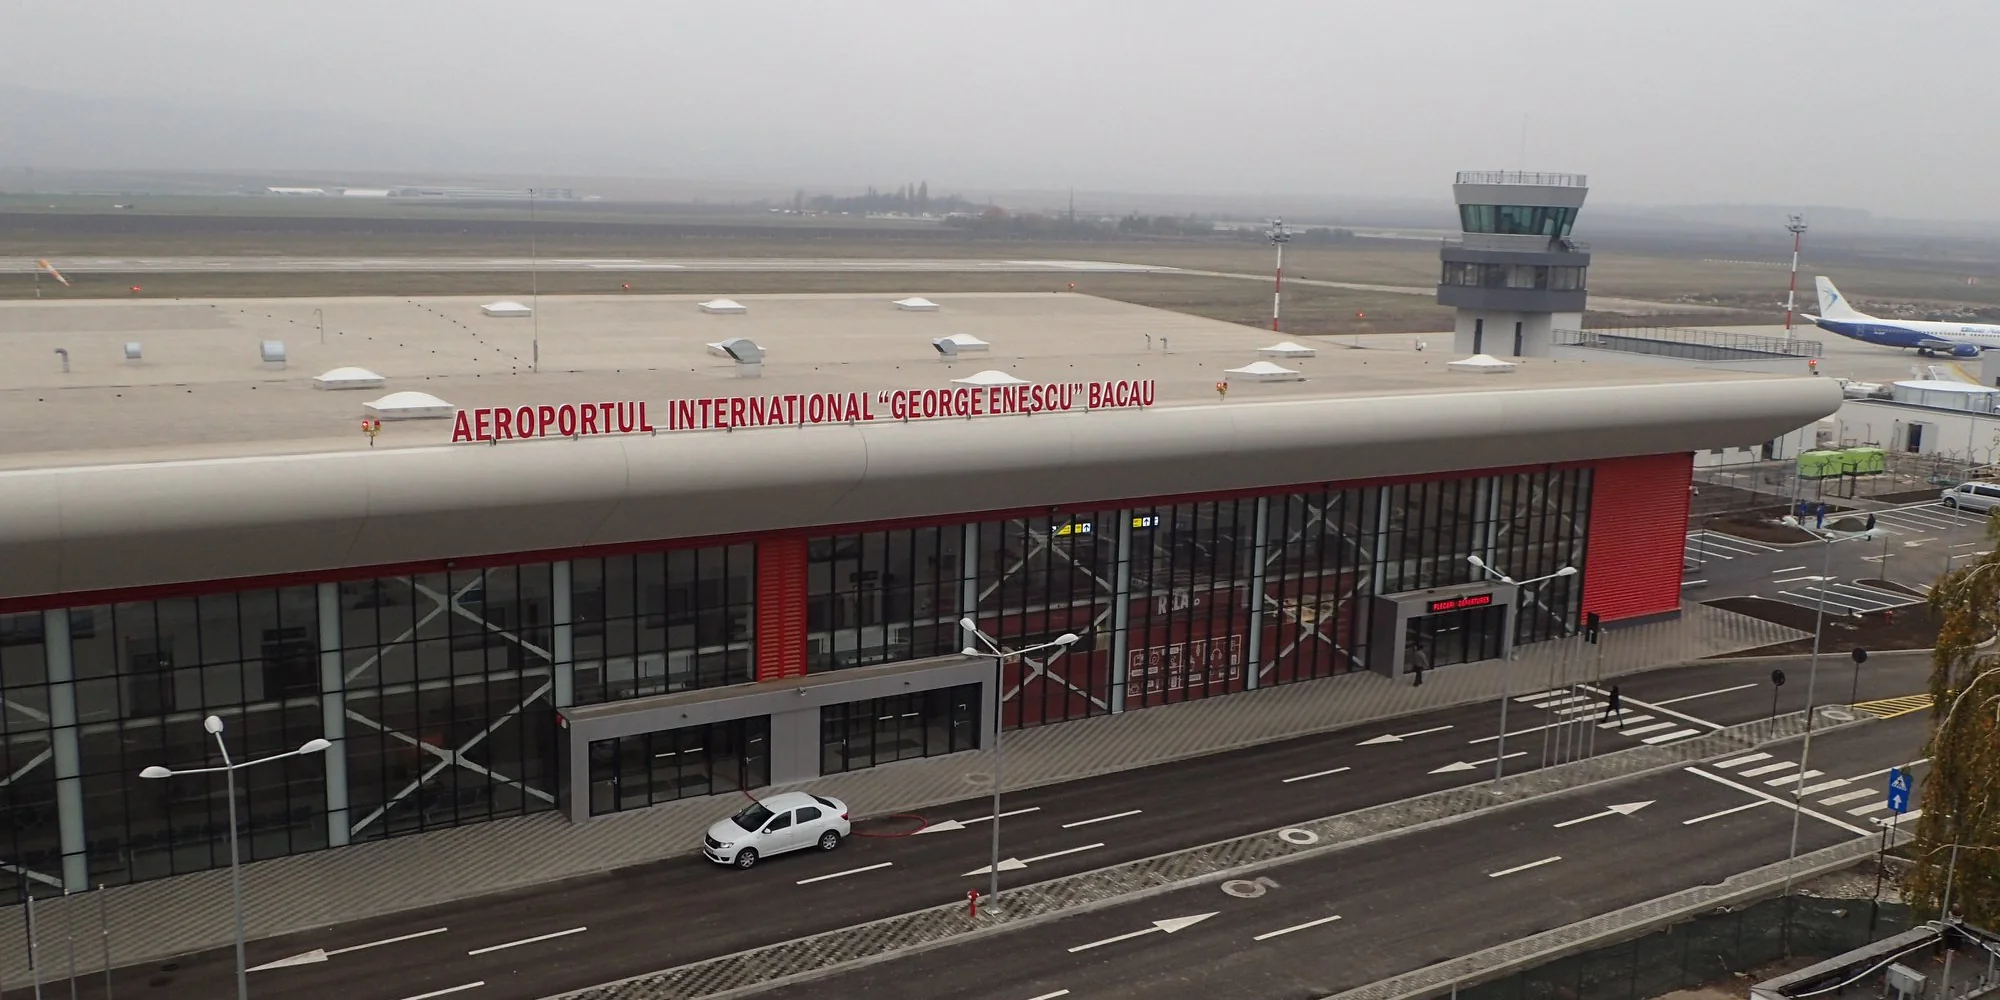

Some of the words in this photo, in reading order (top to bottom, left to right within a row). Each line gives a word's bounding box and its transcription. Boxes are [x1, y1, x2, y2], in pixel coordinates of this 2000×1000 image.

[451, 401, 654, 443] AEROPORTUL
[669, 392, 876, 432] INTERNATIONAL
[1088, 379, 1156, 409] BACAU
